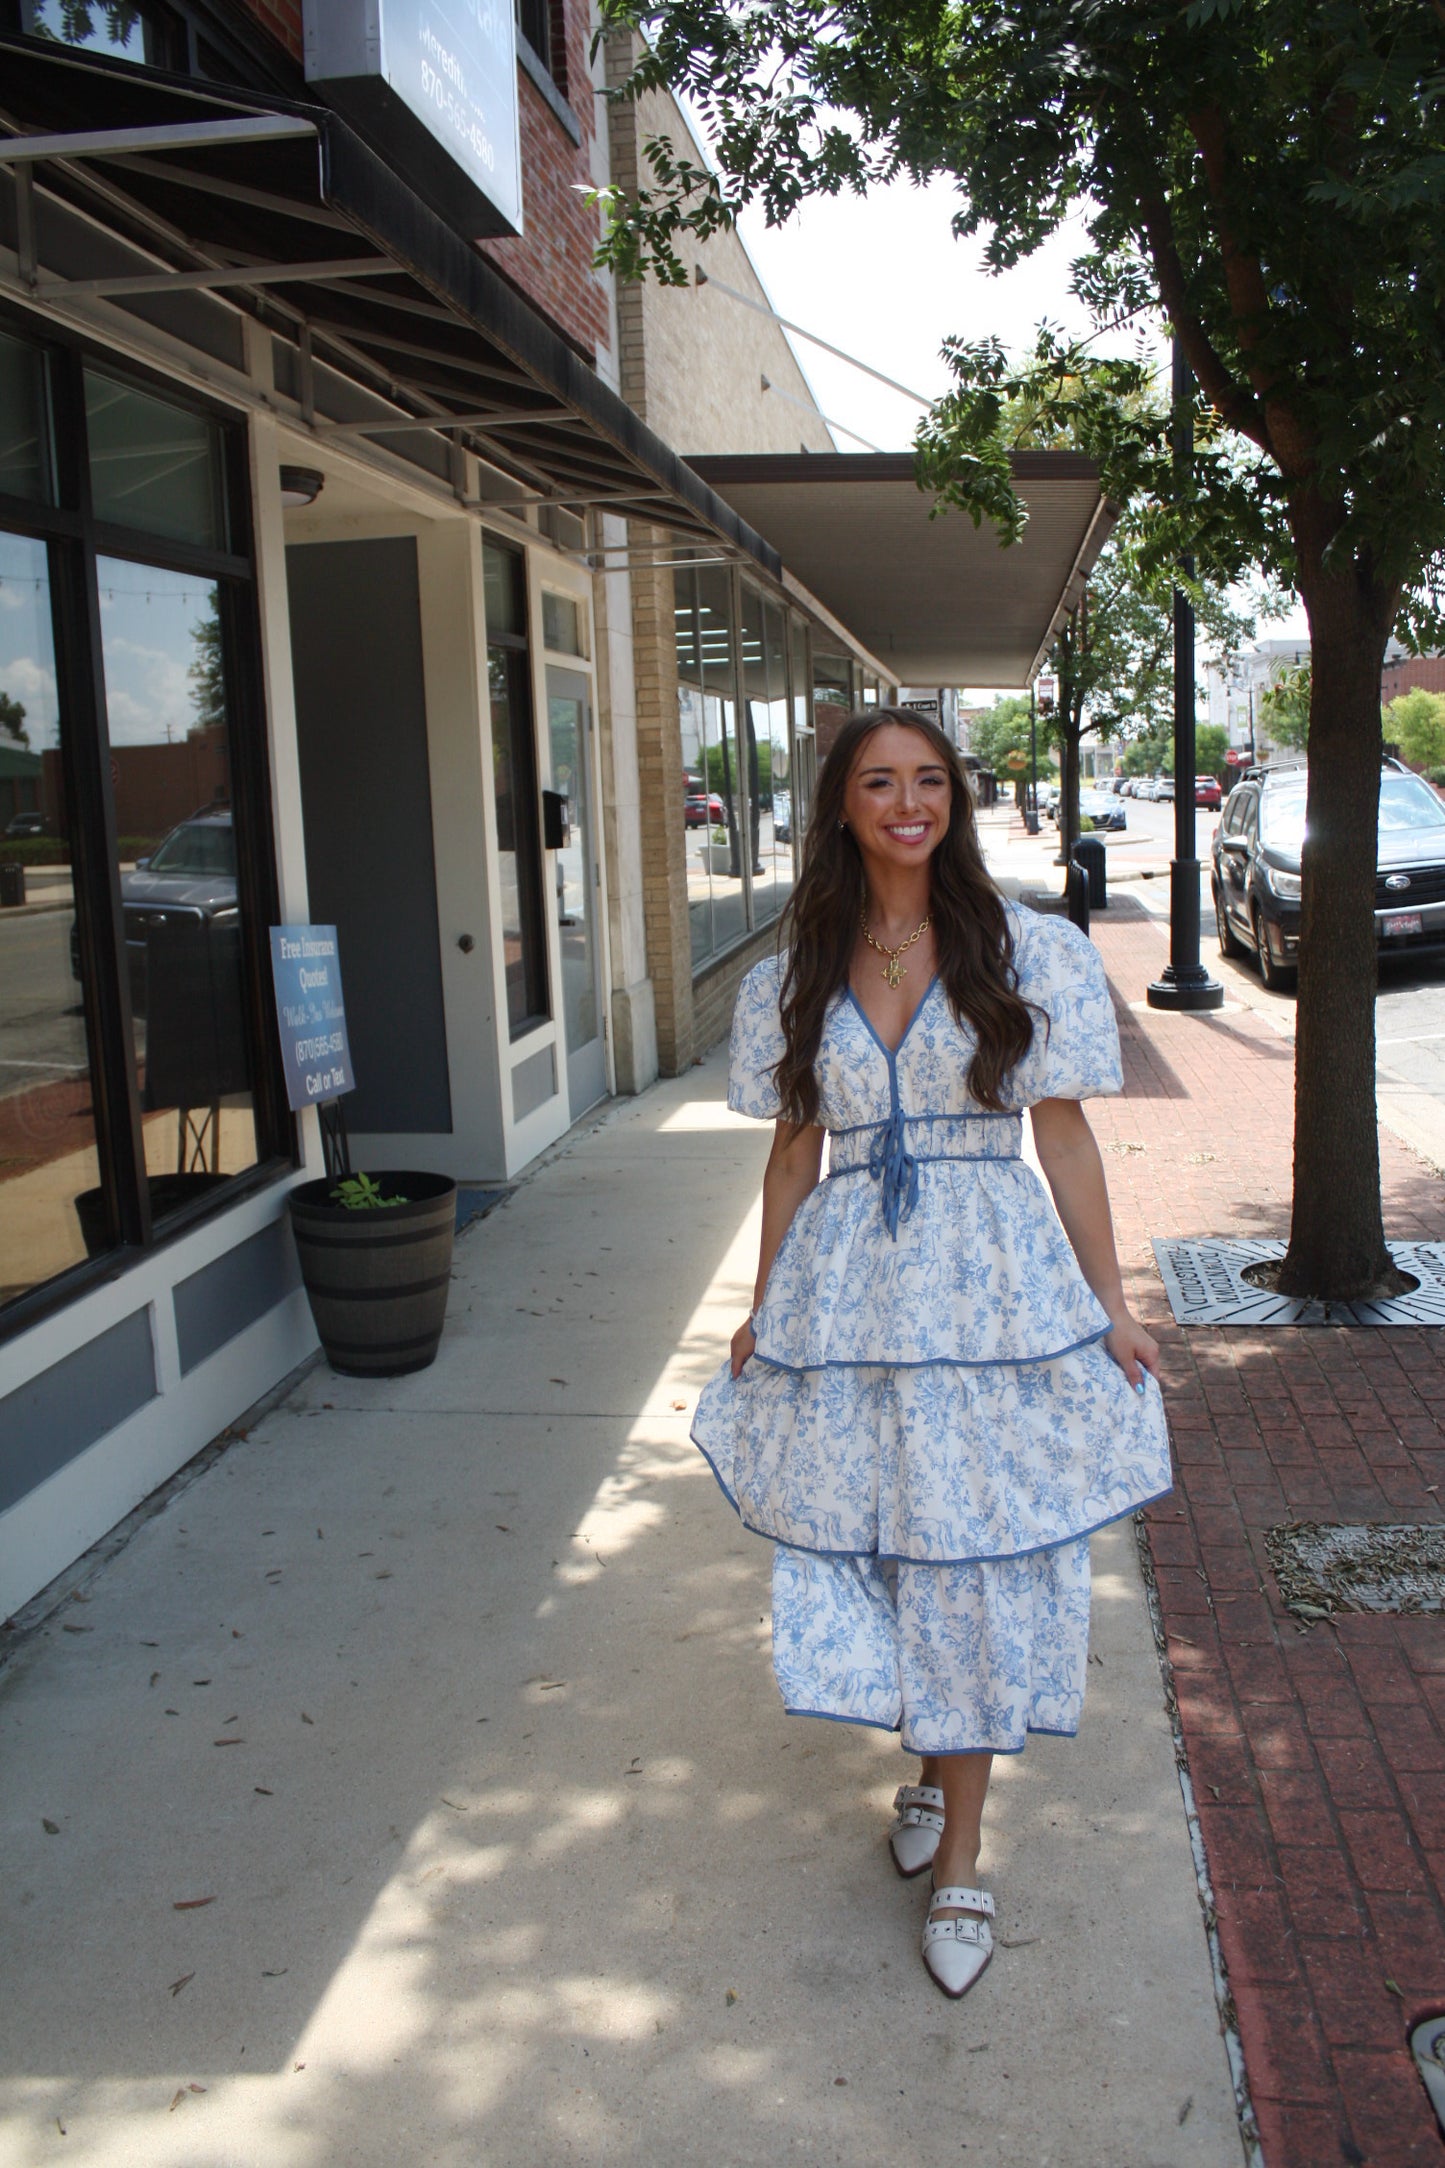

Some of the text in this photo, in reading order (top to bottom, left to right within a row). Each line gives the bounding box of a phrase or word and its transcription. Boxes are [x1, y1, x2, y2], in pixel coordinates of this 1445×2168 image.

[421, 60, 494, 173] 870-565-4580
[280, 936, 334, 960] Free Insurance
[306, 1066, 345, 1095] Call or Text
[1167, 1249, 1208, 1305] PARAGOULD
[1197, 1252, 1241, 1304] DOWNTOWN
